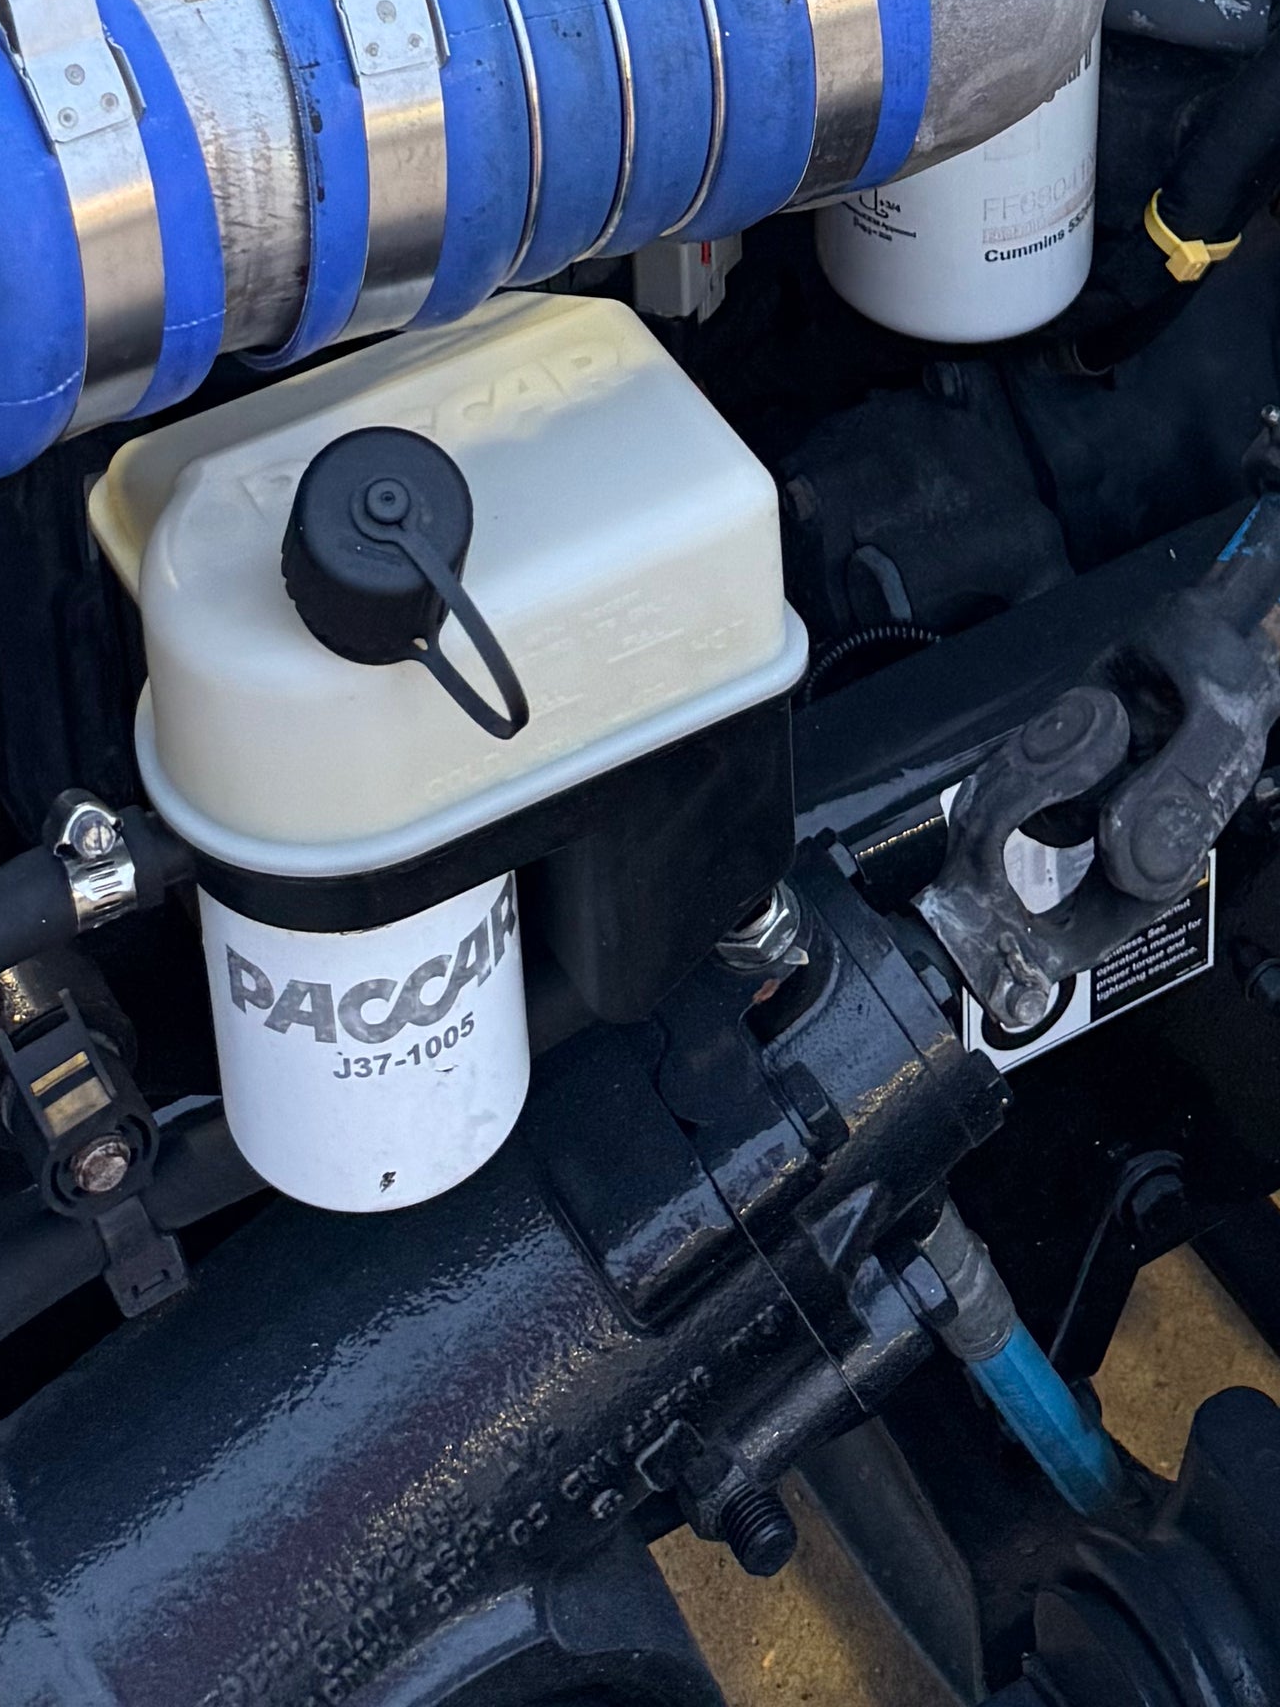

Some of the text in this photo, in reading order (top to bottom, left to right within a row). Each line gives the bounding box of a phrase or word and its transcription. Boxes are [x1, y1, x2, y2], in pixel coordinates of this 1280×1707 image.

[984, 228, 1066, 263] Cummins
[1149, 924, 1187, 950] manual
[1187, 918, 1203, 931] for
[225, 870, 518, 1045] PACCAR
[1096, 968, 1131, 992] proper
[1132, 949, 1166, 971] torque
[1166, 937, 1186, 955] and
[1096, 970, 1148, 1002] tightening
[332, 1010, 476, 1080] J37-1005
